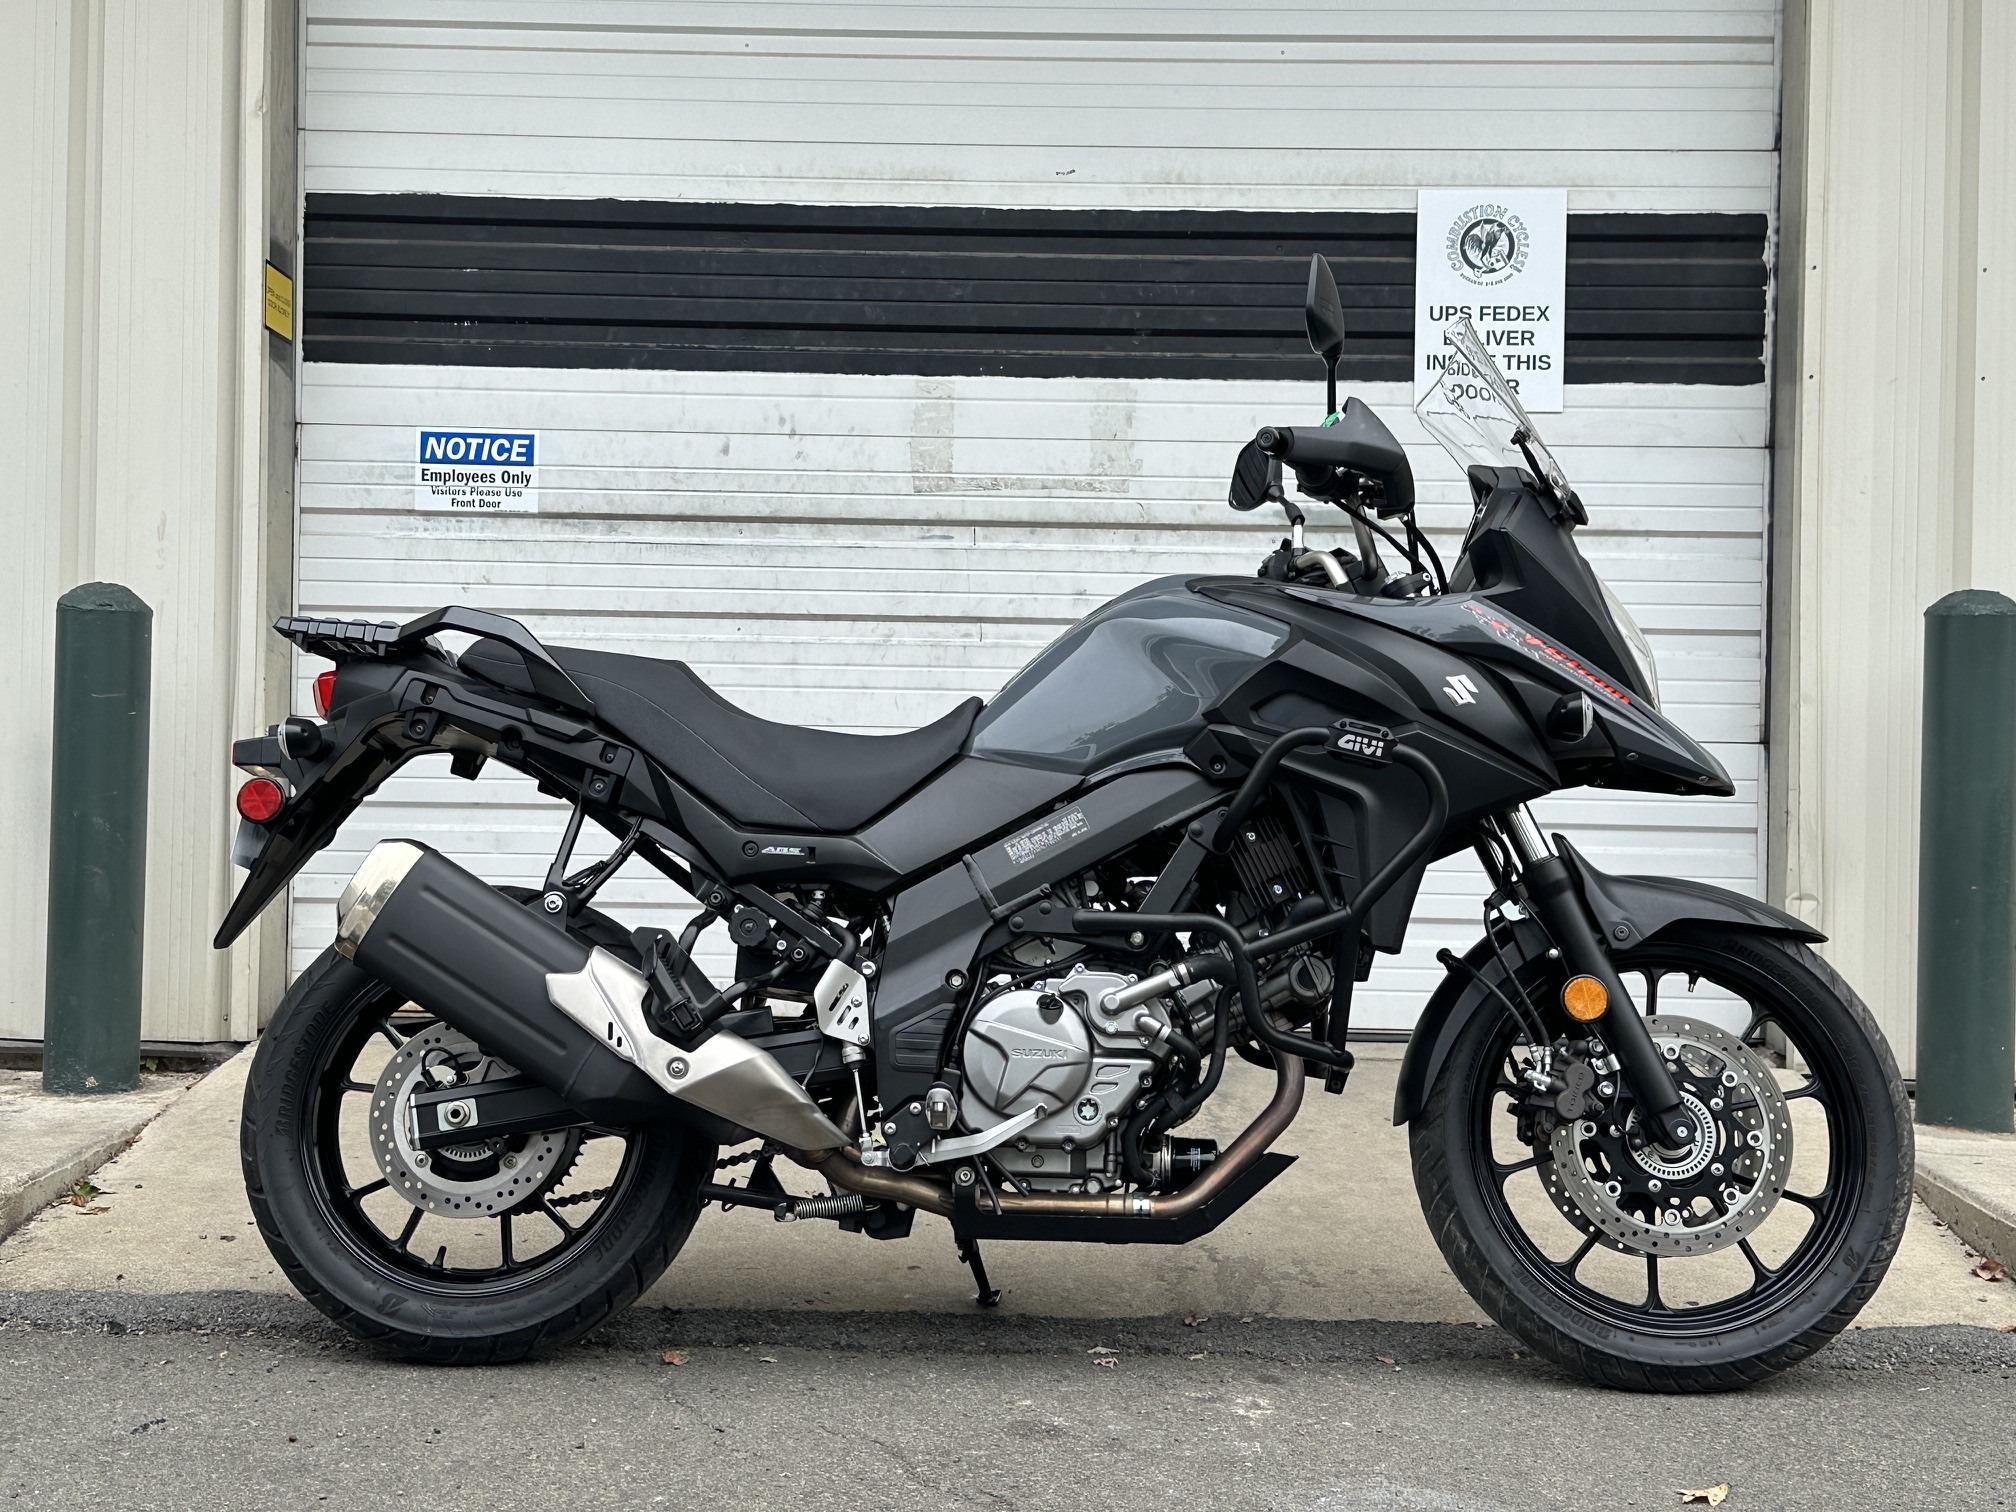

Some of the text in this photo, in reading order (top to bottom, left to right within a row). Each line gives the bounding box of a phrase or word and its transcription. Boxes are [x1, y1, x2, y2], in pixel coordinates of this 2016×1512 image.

[1446, 204, 1508, 271] COMBUSTION
[1429, 306, 1550, 321] UPS FEDEX
[1443, 330, 1535, 346] IVER
[1503, 355, 1551, 370] THIS
[425, 436, 530, 462] NOTICE
[421, 468, 531, 487] Employees Only
[431, 485, 523, 497] Visitors Please Use
[451, 498, 501, 508] Front Door
[1337, 733, 1384, 757] GIVI
[1011, 1048, 1068, 1060] SUZUKI
[274, 1000, 335, 1138] BRIDGESTONE
[1512, 1263, 1613, 1340] BRIDGESTONE
